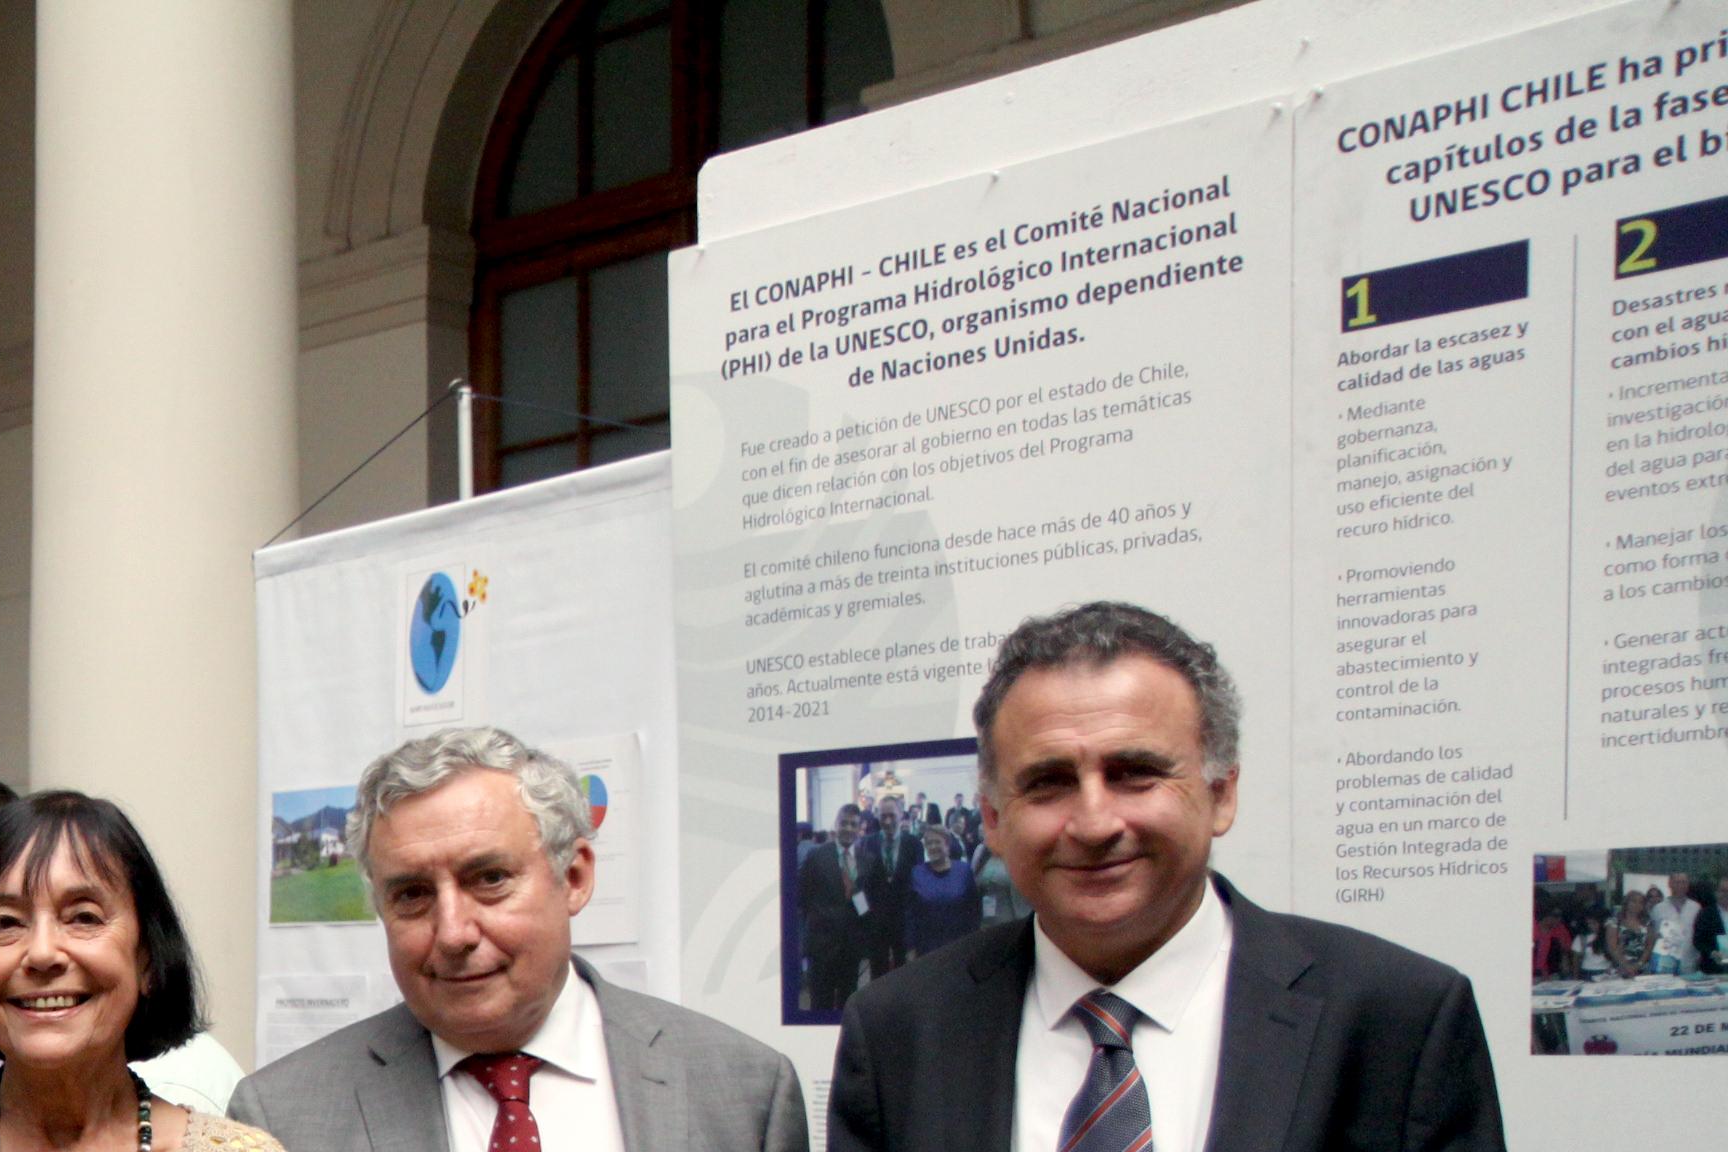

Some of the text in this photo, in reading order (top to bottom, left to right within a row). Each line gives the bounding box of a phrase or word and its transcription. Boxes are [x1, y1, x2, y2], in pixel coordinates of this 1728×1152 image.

[1338, 93, 1488, 153] CONAPHI
[1500, 62, 1606, 112] CHILE
[1618, 55, 1662, 84] ha
[1386, 85, 1728, 184] capítulos de la fase
[1410, 168, 1550, 222] UNESCO
[1562, 153, 1640, 196] para
[1653, 135, 1686, 167] el
[730, 175, 1230, 311] El CONAPHI CHILE es el Comité Nacional
[1617, 217, 1659, 275] 2
[726, 211, 1237, 351] para el Programa Hidrológico Internacional
[1346, 277, 1377, 328] 1
[1612, 285, 1717, 316] Desastres
[721, 255, 1243, 380] (PHI) de la UNESCO, organismo dependiente
[848, 327, 1084, 387] de Naciones Unidas.
[1337, 325, 1511, 367] Abordar la escasez
[1610, 342, 1700, 369] cambios
[1337, 348, 1524, 391] calidad de las aguas
[741, 364, 1188, 456] Fue creado petición de UNESCO por estado de Chile,
[1347, 398, 1426, 421] Mediante
[742, 390, 1191, 481] con fin asesorar gobierno todas las temáticas
[1336, 420, 1437, 449] gobernanza,
[742, 428, 1133, 507] que dicen relación con los objetivos del Programa
[1336, 441, 1446, 472] planificación,
[1336, 456, 1497, 492] manejo, asignación
[1336, 482, 1474, 515] uso eficiente del
[1605, 480, 1680, 502] eventos
[742, 485, 933, 529] Hidrológico Internacional.
[760, 504, 1176, 575] comité chileno funciona desde hace más 40 años
[1336, 512, 1453, 538] recuro hídrico.
[1616, 528, 1694, 549] Manejar
[744, 527, 1202, 605] aglutina más treinta instituciones públicas, privadas,
[1346, 557, 1455, 583] Promoviendo
[1661, 550, 1719, 568] forma
[745, 591, 925, 626] académicas gremiales.
[1336, 584, 1445, 607] herramientas
[1337, 604, 1477, 630] innovadoras para
[1336, 635, 1406, 654] asegurar
[1614, 630, 1690, 649] Generar
[746, 653, 804, 674] UNESCO
[808, 648, 880, 667] establece
[885, 641, 935, 662] planes
[1336, 652, 1464, 676] abastecimiento
[1602, 652, 1702, 675] integradas
[746, 683, 782, 698] años.
[786, 672, 882, 693] Actualmente
[886, 665, 919, 683] está
[923, 661, 982, 682] vigente
[1336, 680, 1393, 699] control
[1601, 680, 1685, 702] procesos
[748, 700, 829, 722] 2014-2021
[1336, 698, 1460, 721] contaminación.
[1601, 703, 1688, 723] naturales
[1345, 745, 1462, 766] Abordando los
[1336, 763, 1512, 793] problemas calidad
[1349, 788, 1502, 812] contaminación del
[1335, 817, 1480, 838] agua marco
[1336, 836, 1482, 858] Gestión Integrada
[1336, 860, 1508, 880] los Recursos Hídricos
[1336, 888, 1384, 903] (GIRH)
[1669, 1025, 1690, 1037] 22
[1694, 1022, 1716, 1034] DE
